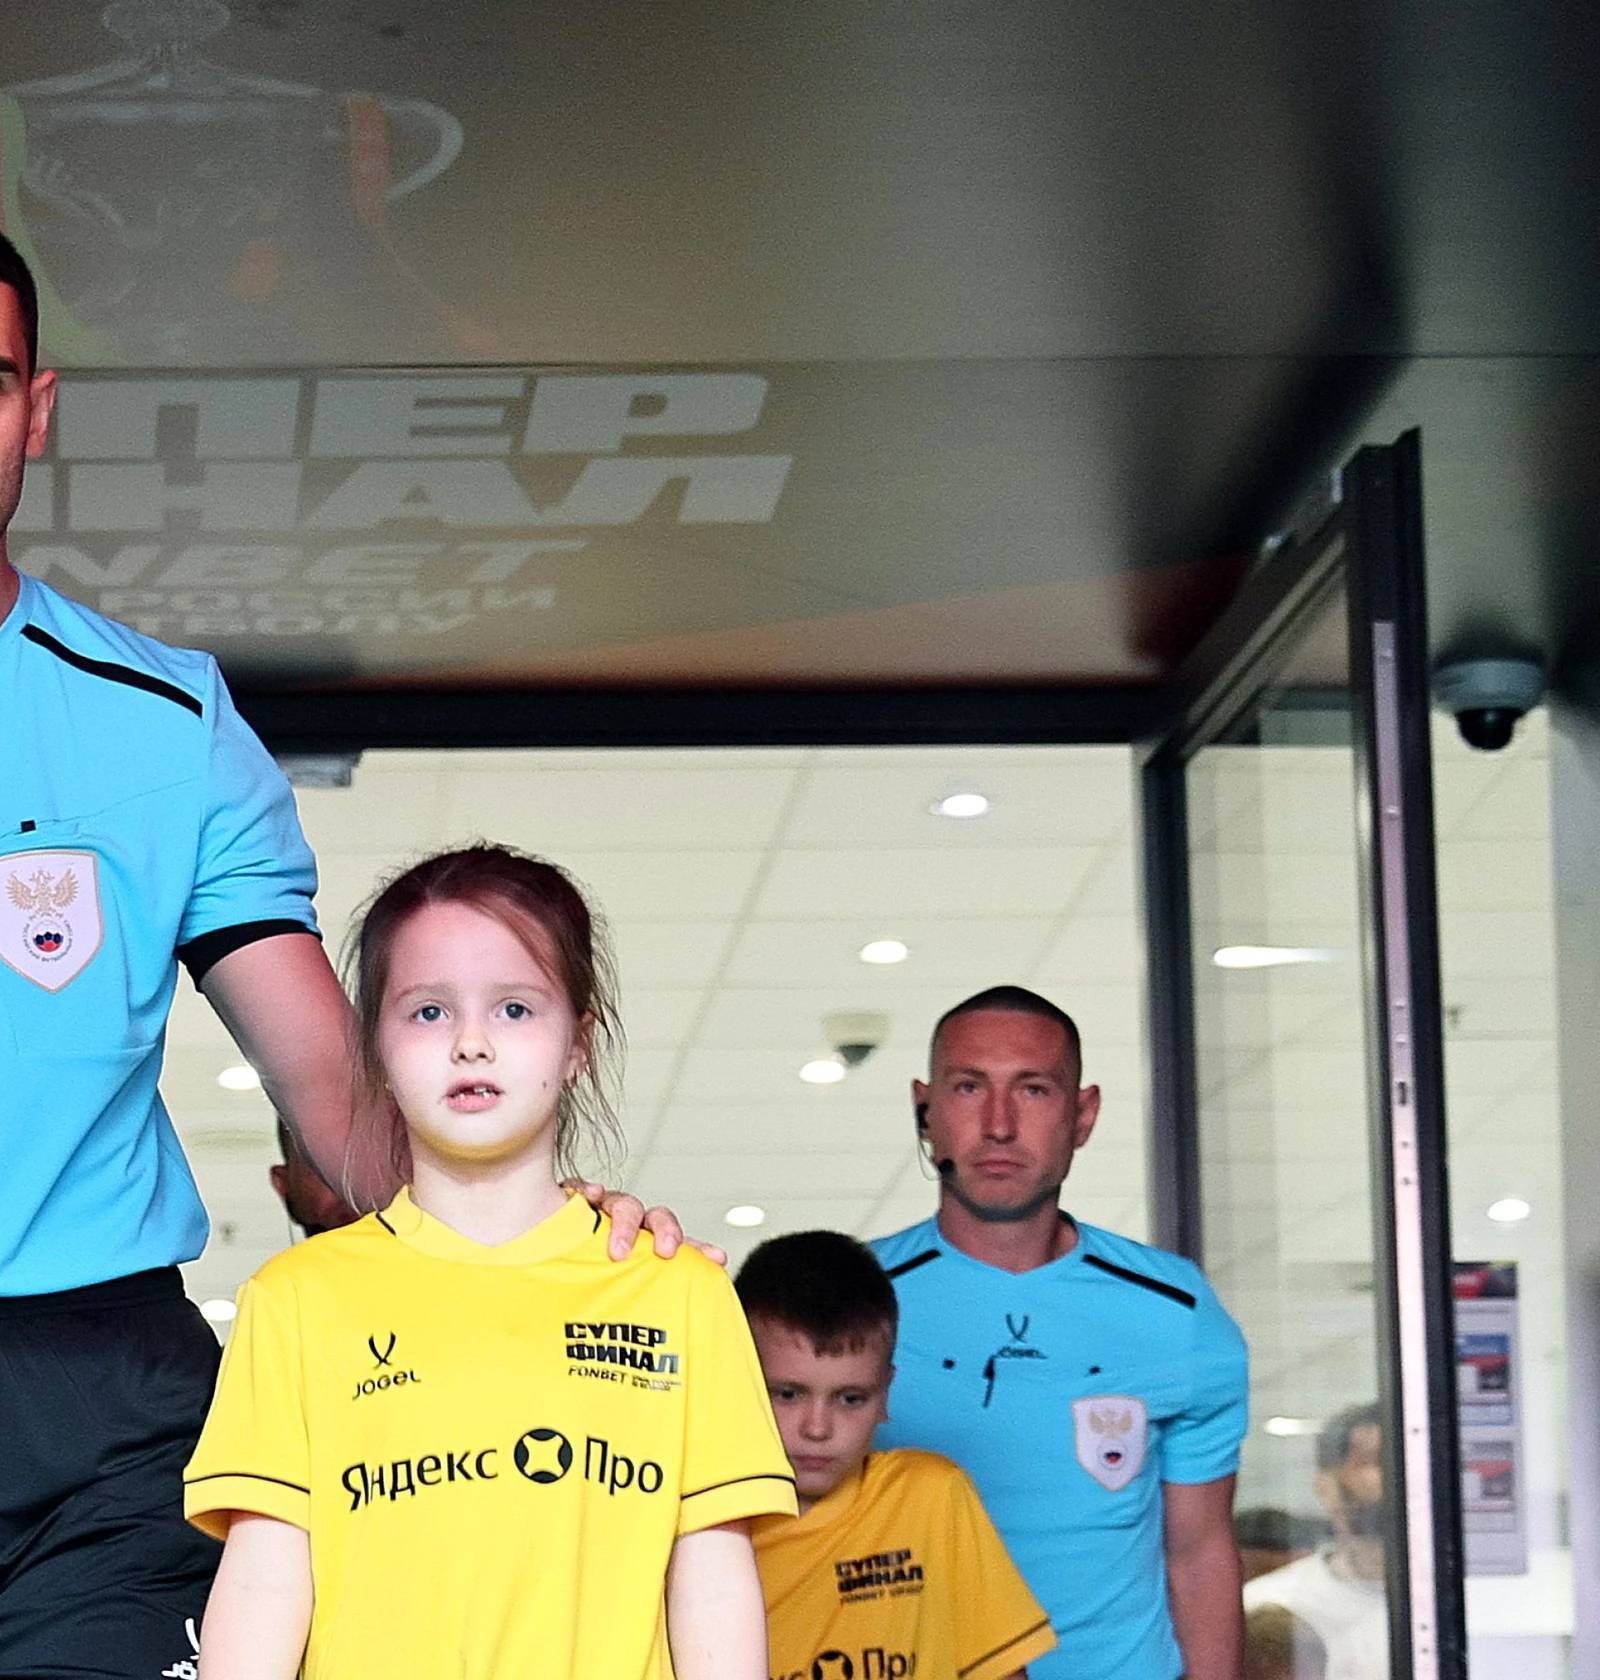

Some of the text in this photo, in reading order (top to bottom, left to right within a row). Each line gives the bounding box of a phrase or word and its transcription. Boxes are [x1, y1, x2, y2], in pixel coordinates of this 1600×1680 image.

[119, 611, 478, 638] ТБОЛУ
[565, 1322, 667, 1348] СУПЕР
[566, 1341, 679, 1374] ФИНАЛ
[568, 1366, 628, 1385] FONBET
[341, 1436, 663, 1511] Яндекс Про
